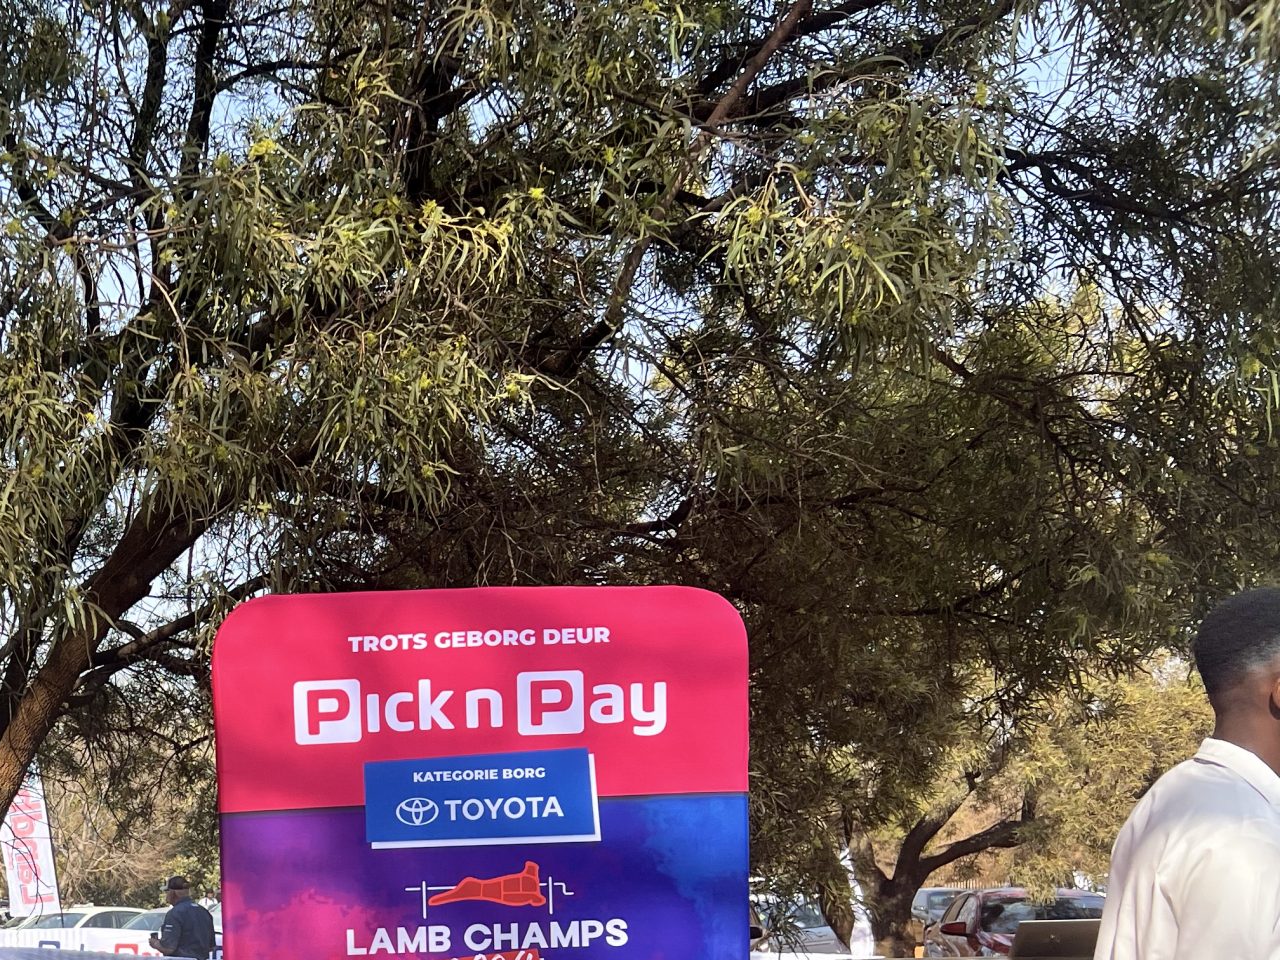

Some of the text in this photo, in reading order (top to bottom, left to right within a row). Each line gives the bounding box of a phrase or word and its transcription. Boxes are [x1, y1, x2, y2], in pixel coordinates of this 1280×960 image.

[348, 626, 611, 653] TROTS GEBORG DEUR
[293, 669, 667, 746] Pick n Pay
[413, 766, 546, 784] KATEGORIE BORG
[444, 796, 564, 821] TOYOTA
[346, 918, 629, 956] LAMB CHAMPS
